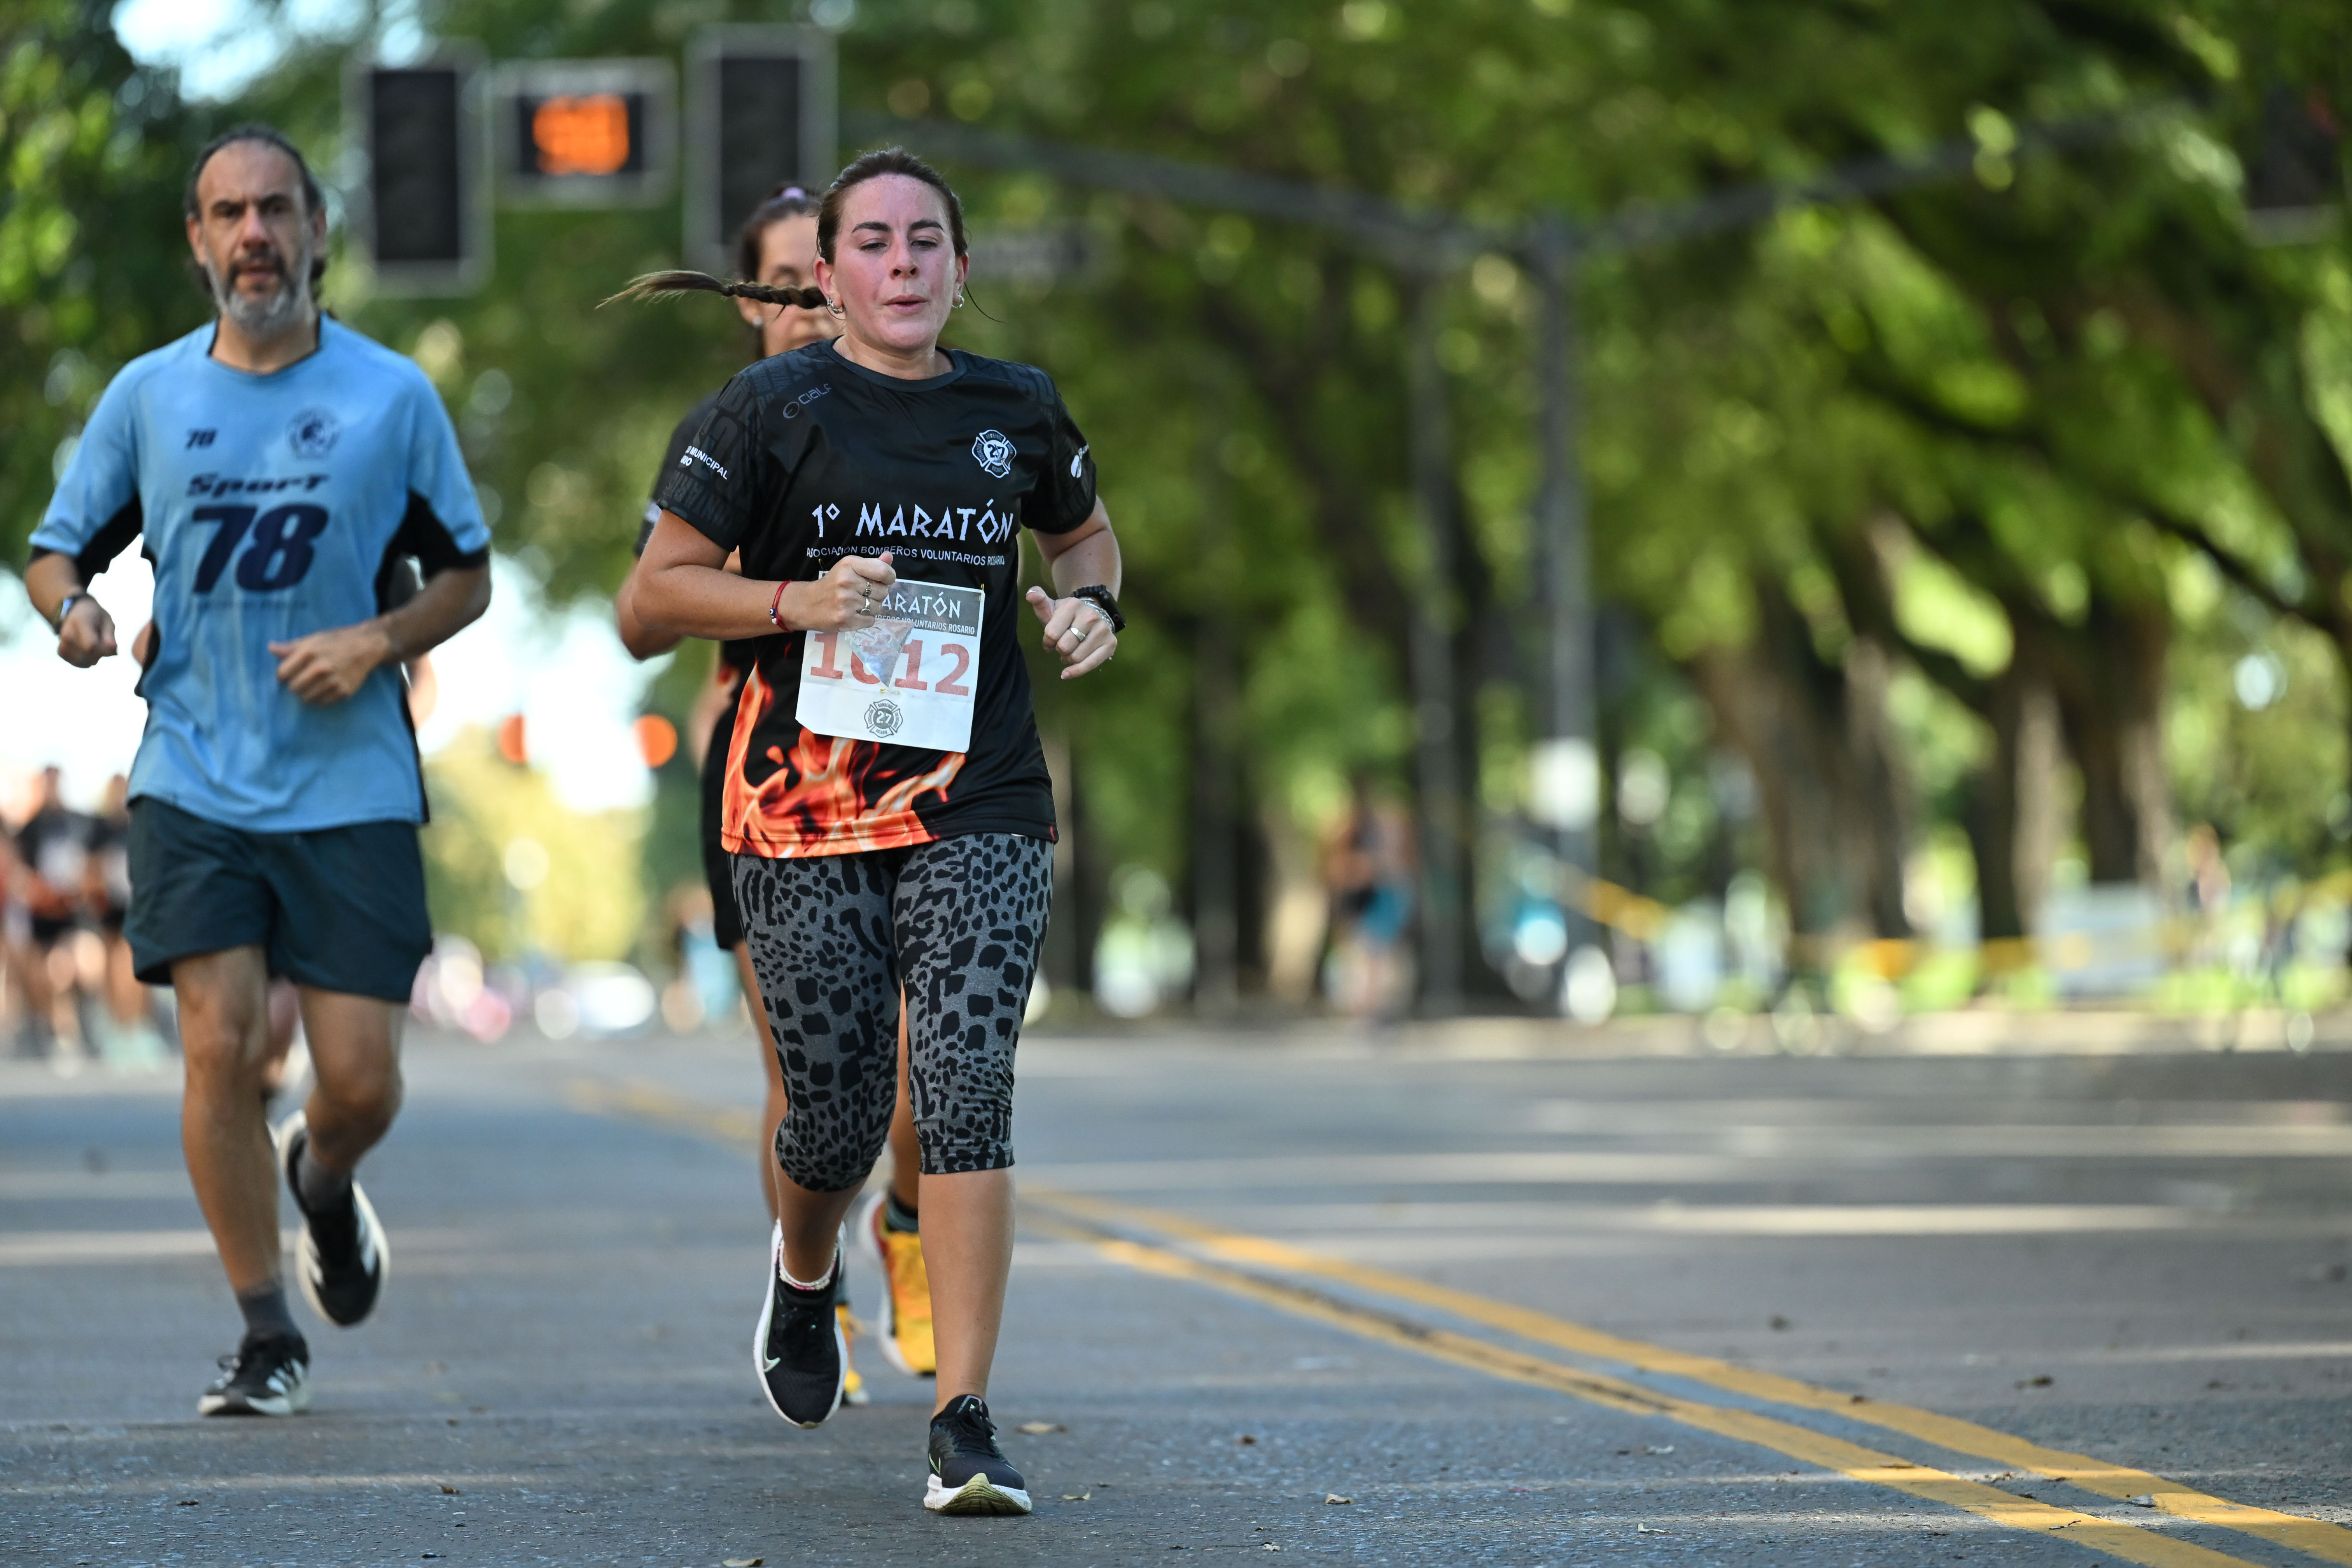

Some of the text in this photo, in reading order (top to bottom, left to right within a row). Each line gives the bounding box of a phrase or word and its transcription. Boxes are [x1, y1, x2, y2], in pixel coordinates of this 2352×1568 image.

[987, 444, 1005, 458] 27
[690, 447, 727, 480] MUNICIPAL
[856, 499, 1013, 544] MARATÓN
[192, 504, 329, 594] 78
[807, 546, 857, 558] ASOCIACIÓN
[861, 546, 917, 558] BOMBEROS
[920, 549, 985, 565] VOLUNTARIOS
[882, 592, 961, 619] ARATÓN
[948, 623, 975, 635] ROSARIO
[876, 710, 892, 724] 27
